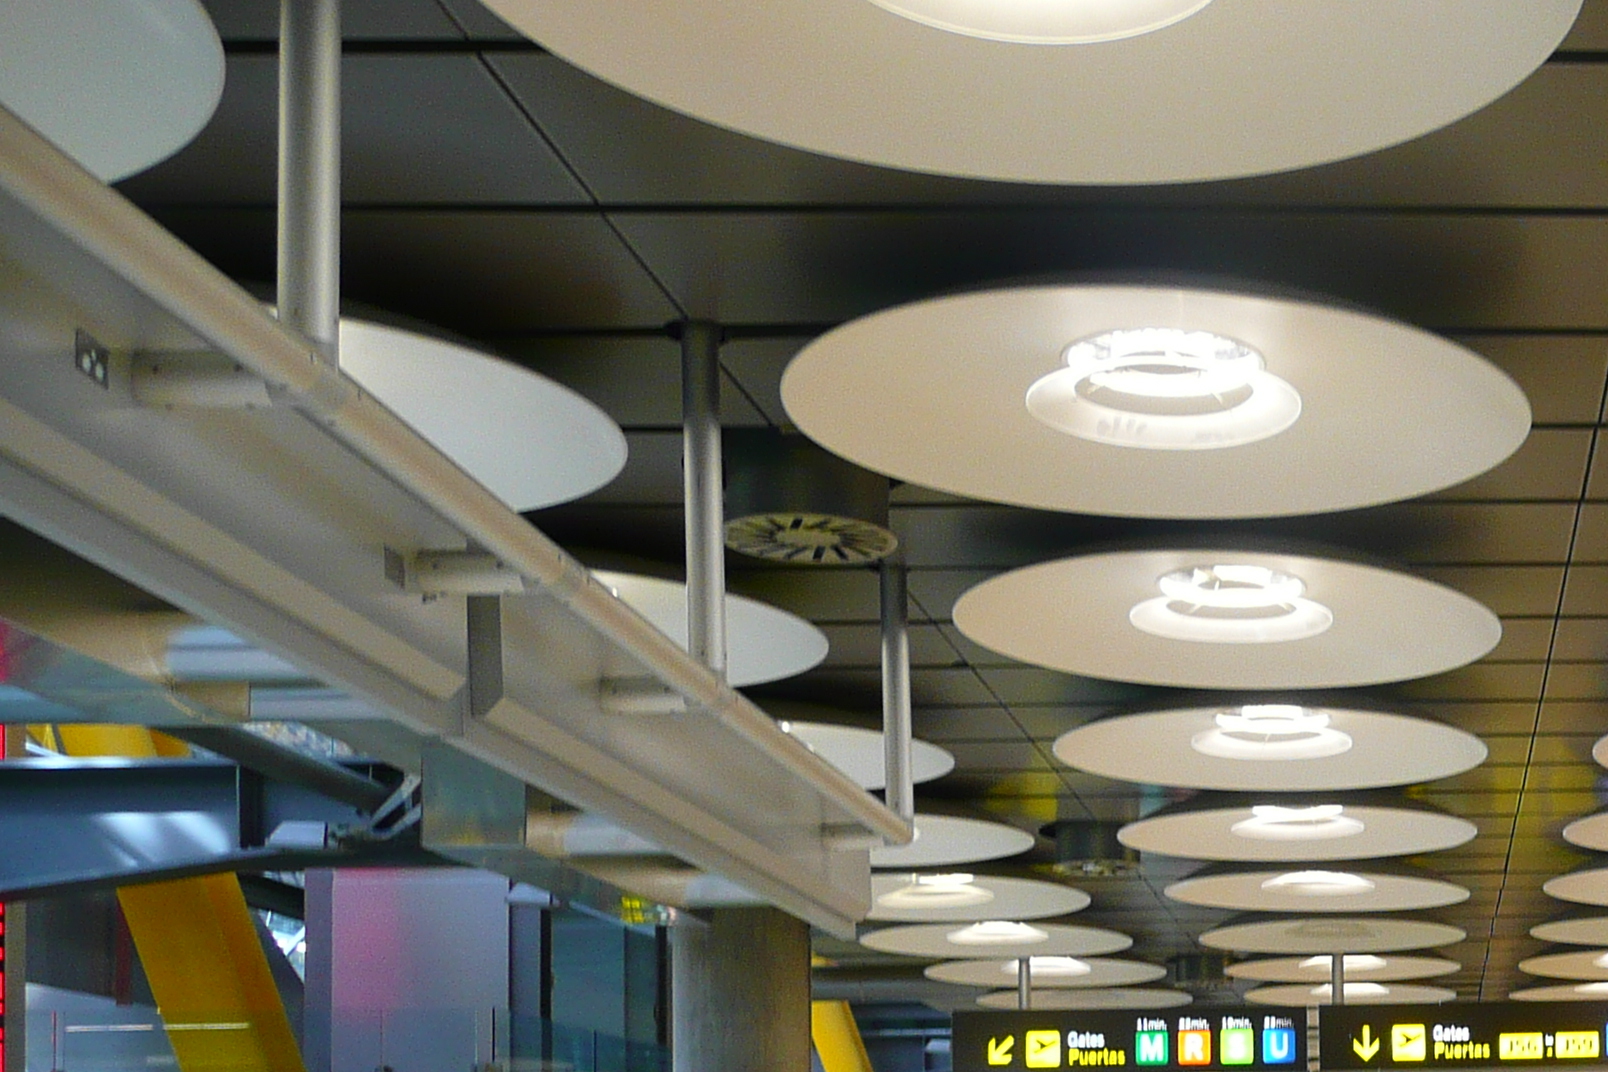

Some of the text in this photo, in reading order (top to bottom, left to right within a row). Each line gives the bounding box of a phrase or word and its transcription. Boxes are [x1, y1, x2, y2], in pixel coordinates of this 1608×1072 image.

[1067, 1030, 1105, 1048] Gates
[1432, 1023, 1470, 1042] Gates
[1068, 1046, 1126, 1066] Puertas
[1140, 1033, 1164, 1062] M
[1183, 1032, 1205, 1062] R
[1270, 1031, 1290, 1060] U
[1434, 1040, 1490, 1060] Puertas
